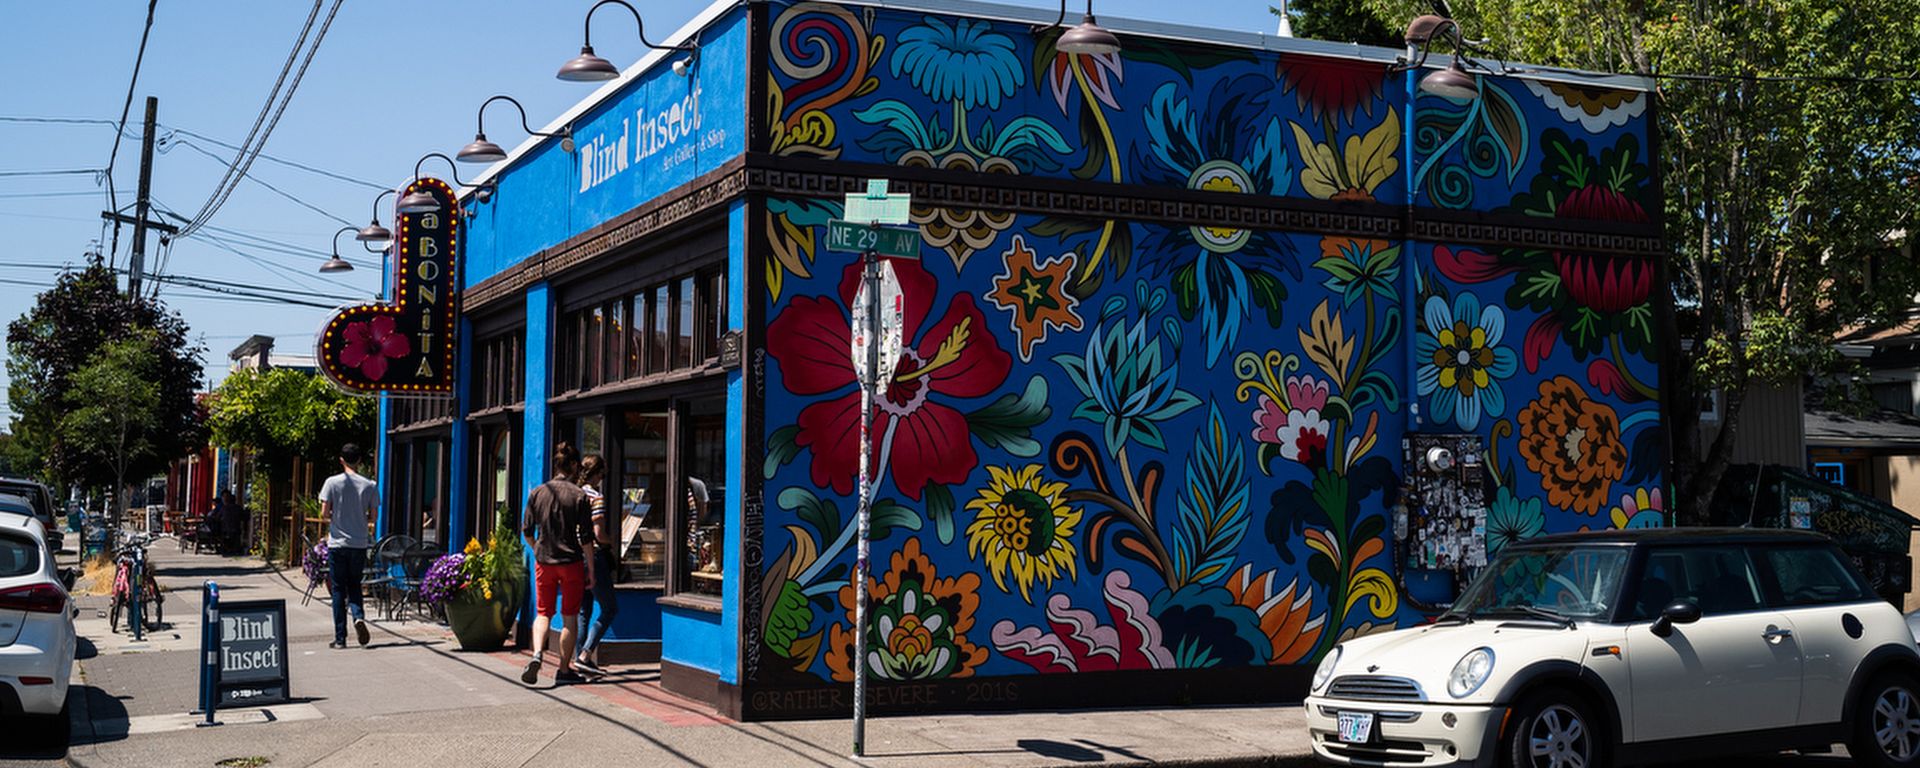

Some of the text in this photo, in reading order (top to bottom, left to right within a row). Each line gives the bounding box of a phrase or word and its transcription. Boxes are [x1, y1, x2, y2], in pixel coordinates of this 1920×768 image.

[579, 78, 702, 194] Blind Insect
[663, 155, 674, 171] Art
[707, 128, 726, 149] Shop
[831, 225, 852, 247] NE
[895, 234, 914, 252] AV
[220, 614, 276, 642] Blind
[221, 643, 279, 672] Insect
